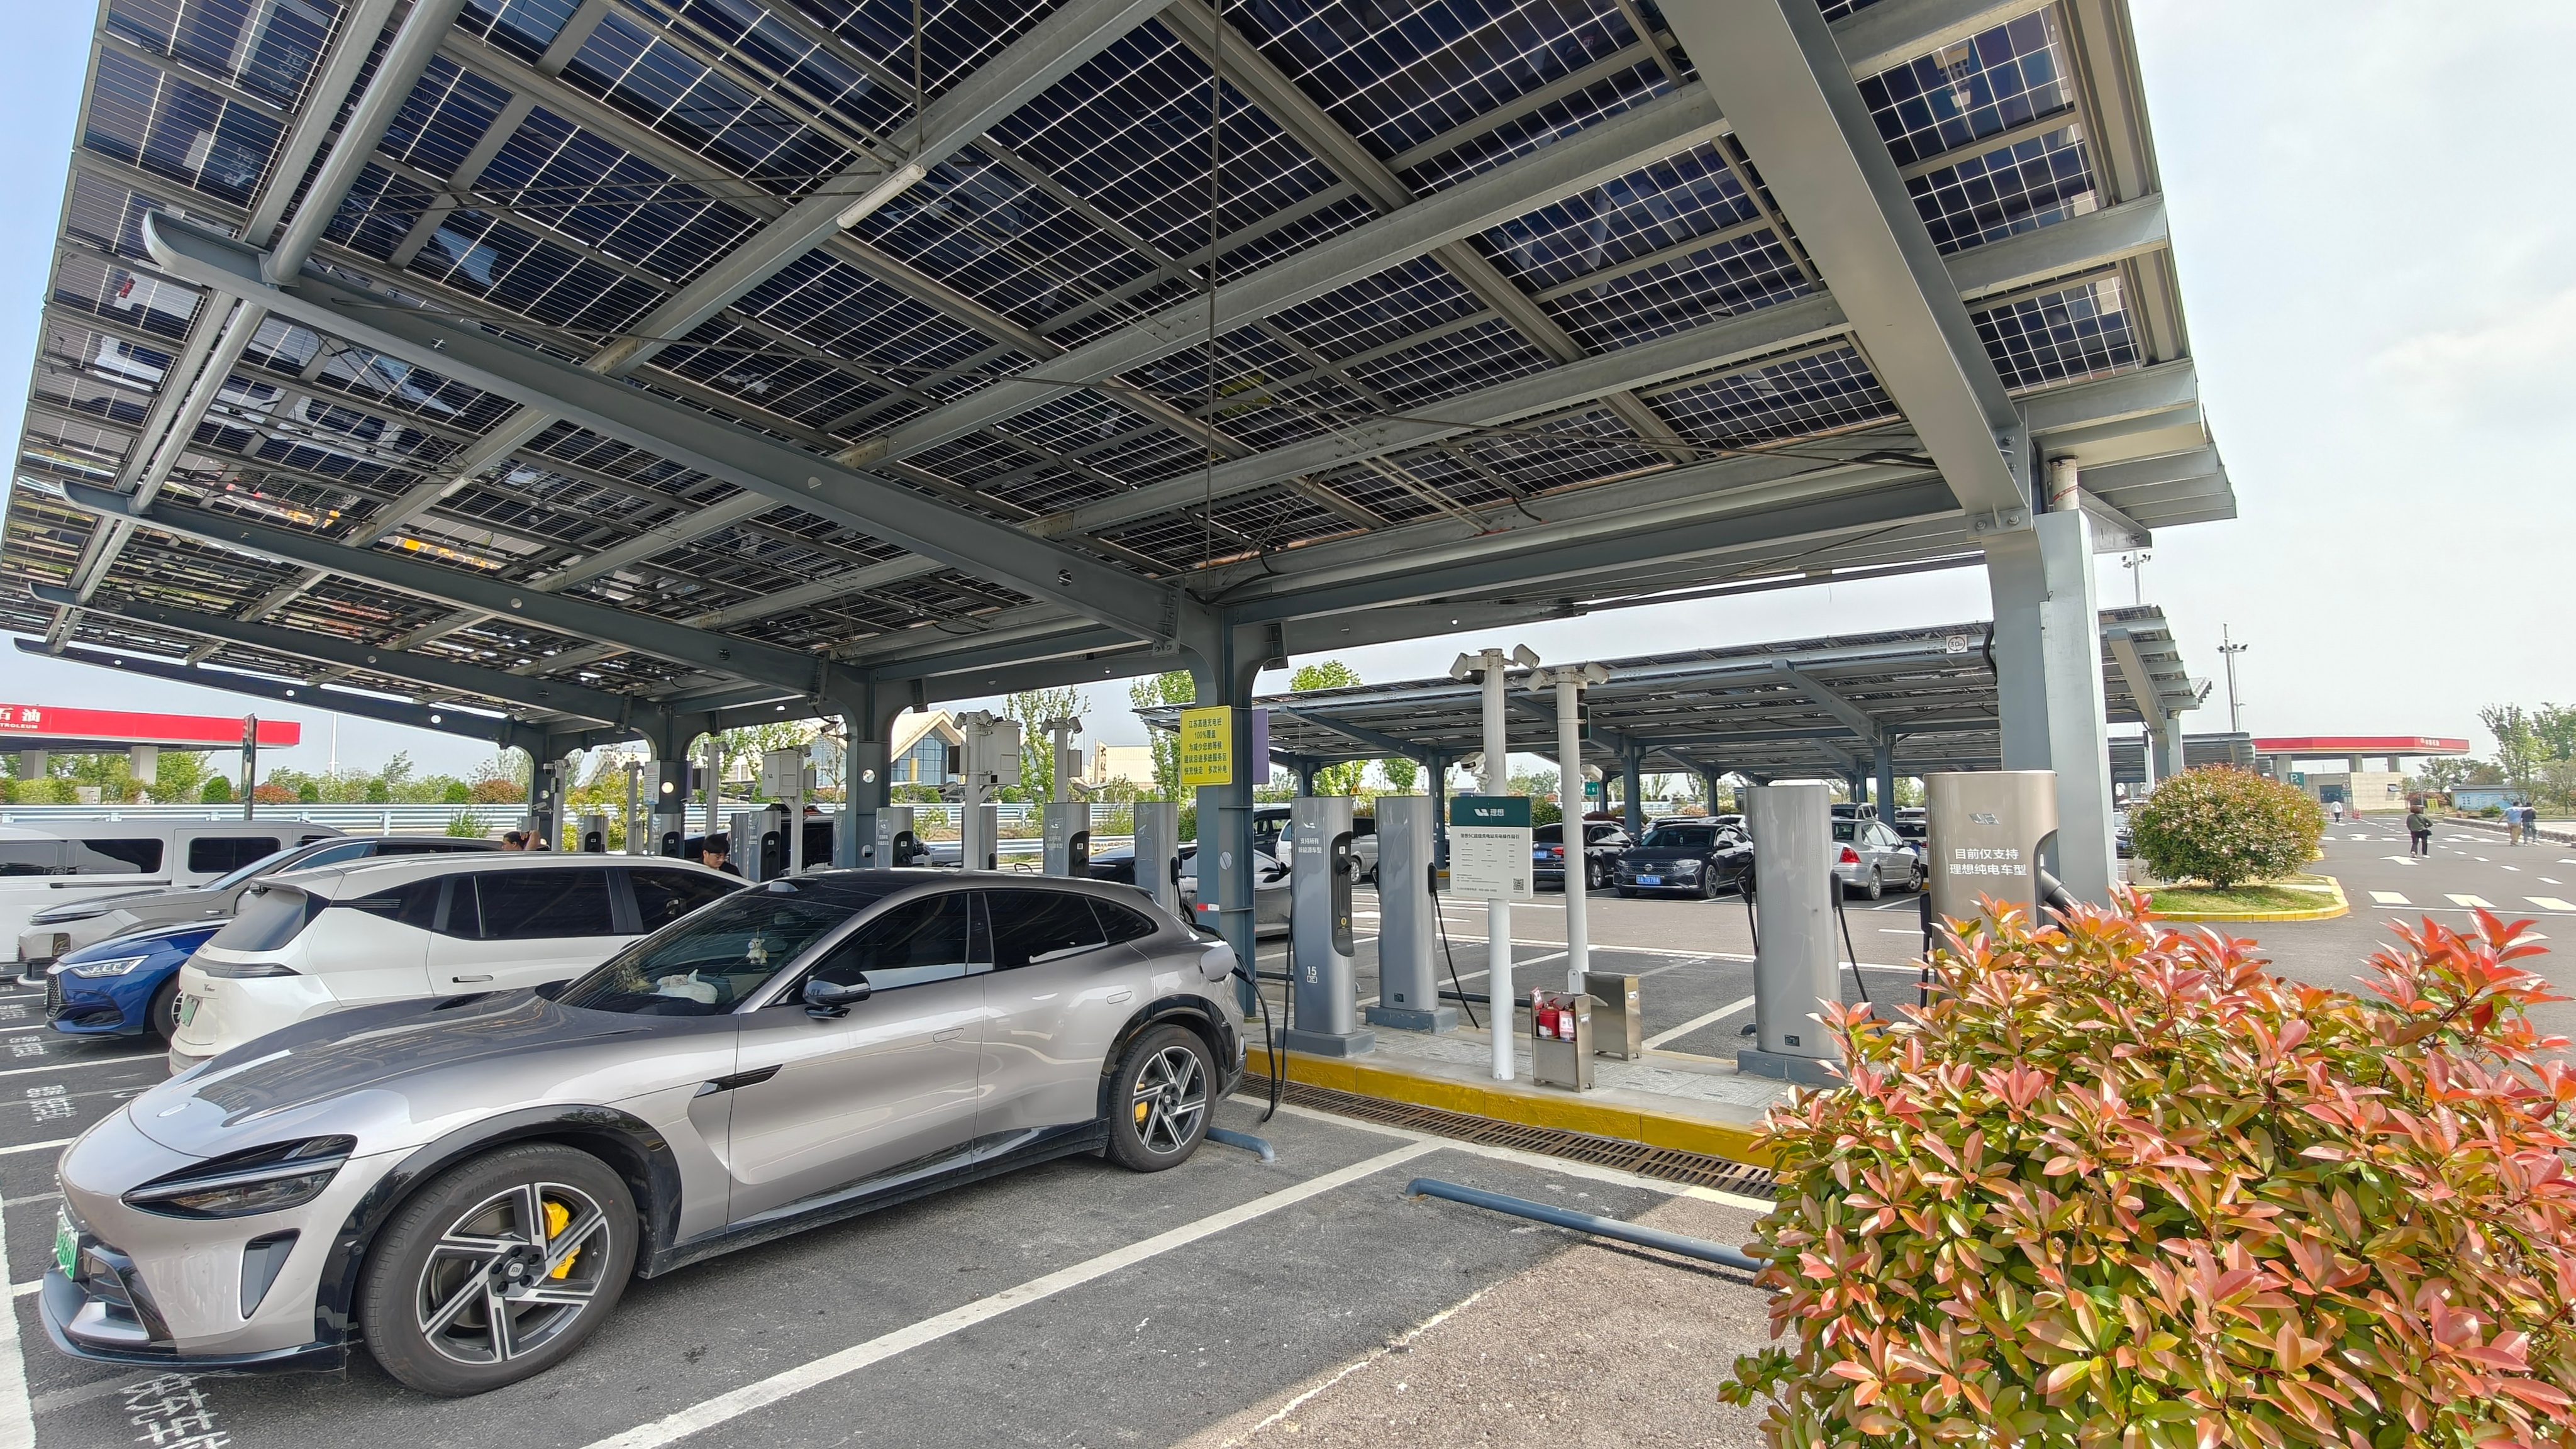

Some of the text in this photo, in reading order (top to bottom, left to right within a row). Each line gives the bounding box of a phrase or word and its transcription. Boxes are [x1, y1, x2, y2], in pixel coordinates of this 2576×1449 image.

[1189, 717, 1222, 728] 江苏高速充电桩
[1194, 730, 1216, 739] 100%覆盖
[1955, 848, 2019, 860] 目前仅支持
[1949, 863, 2027, 875] 理想纯电车型
[1307, 966, 1317, 975] 15
